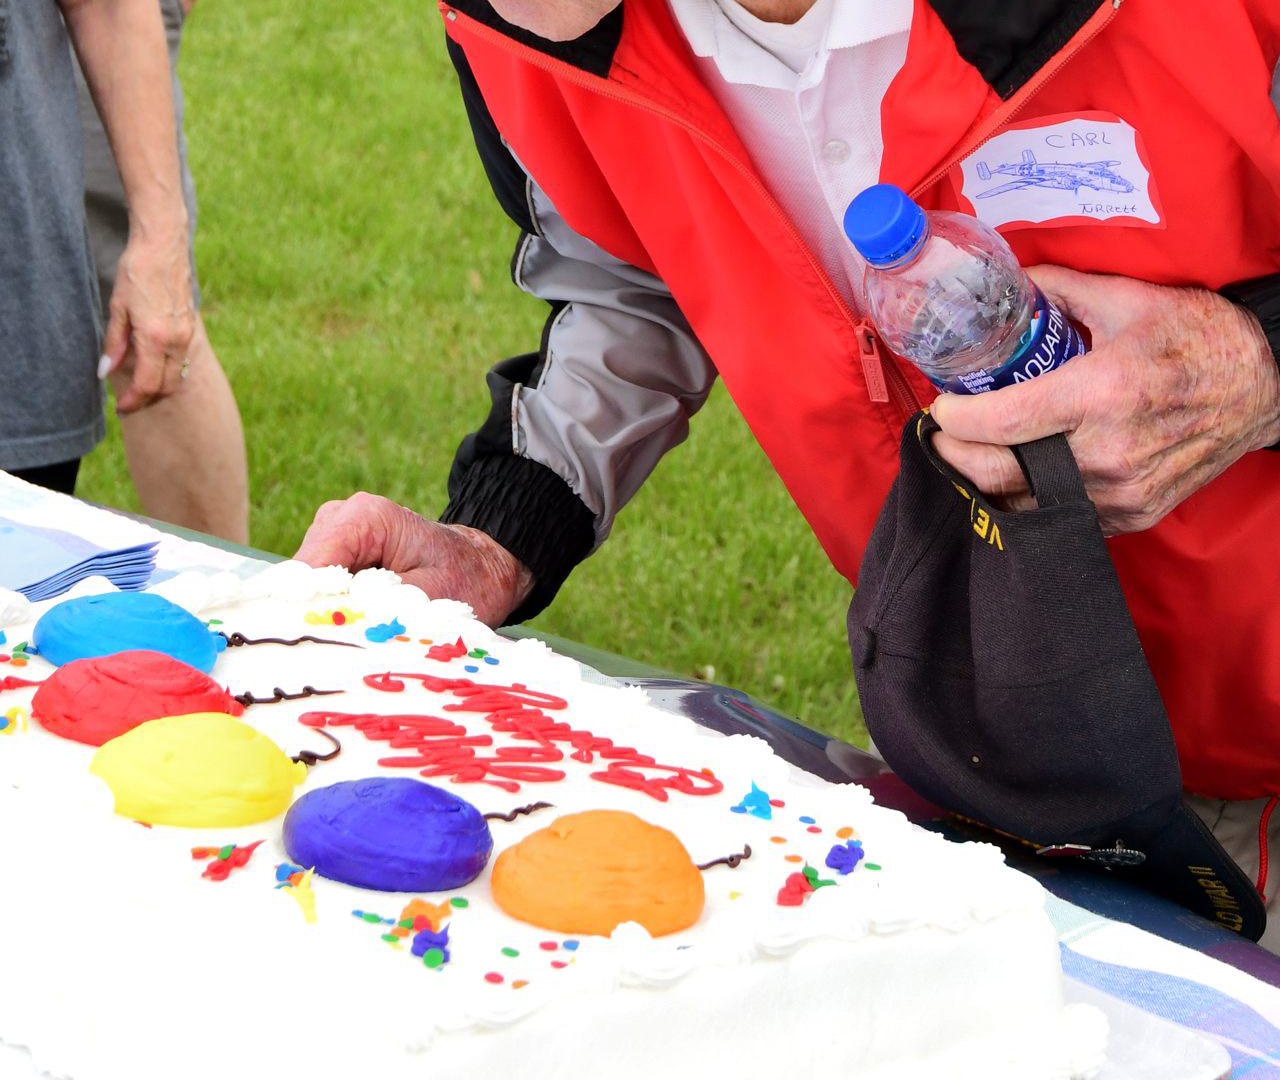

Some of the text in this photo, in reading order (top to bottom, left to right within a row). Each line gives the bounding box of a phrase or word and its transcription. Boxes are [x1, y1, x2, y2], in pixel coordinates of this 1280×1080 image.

[1045, 131, 1111, 149] CARL
[1013, 300, 1063, 385] AQUAFIN
[958, 368, 987, 383] Purified
[963, 375, 995, 390] Drinking
[969, 385, 992, 394] Water
